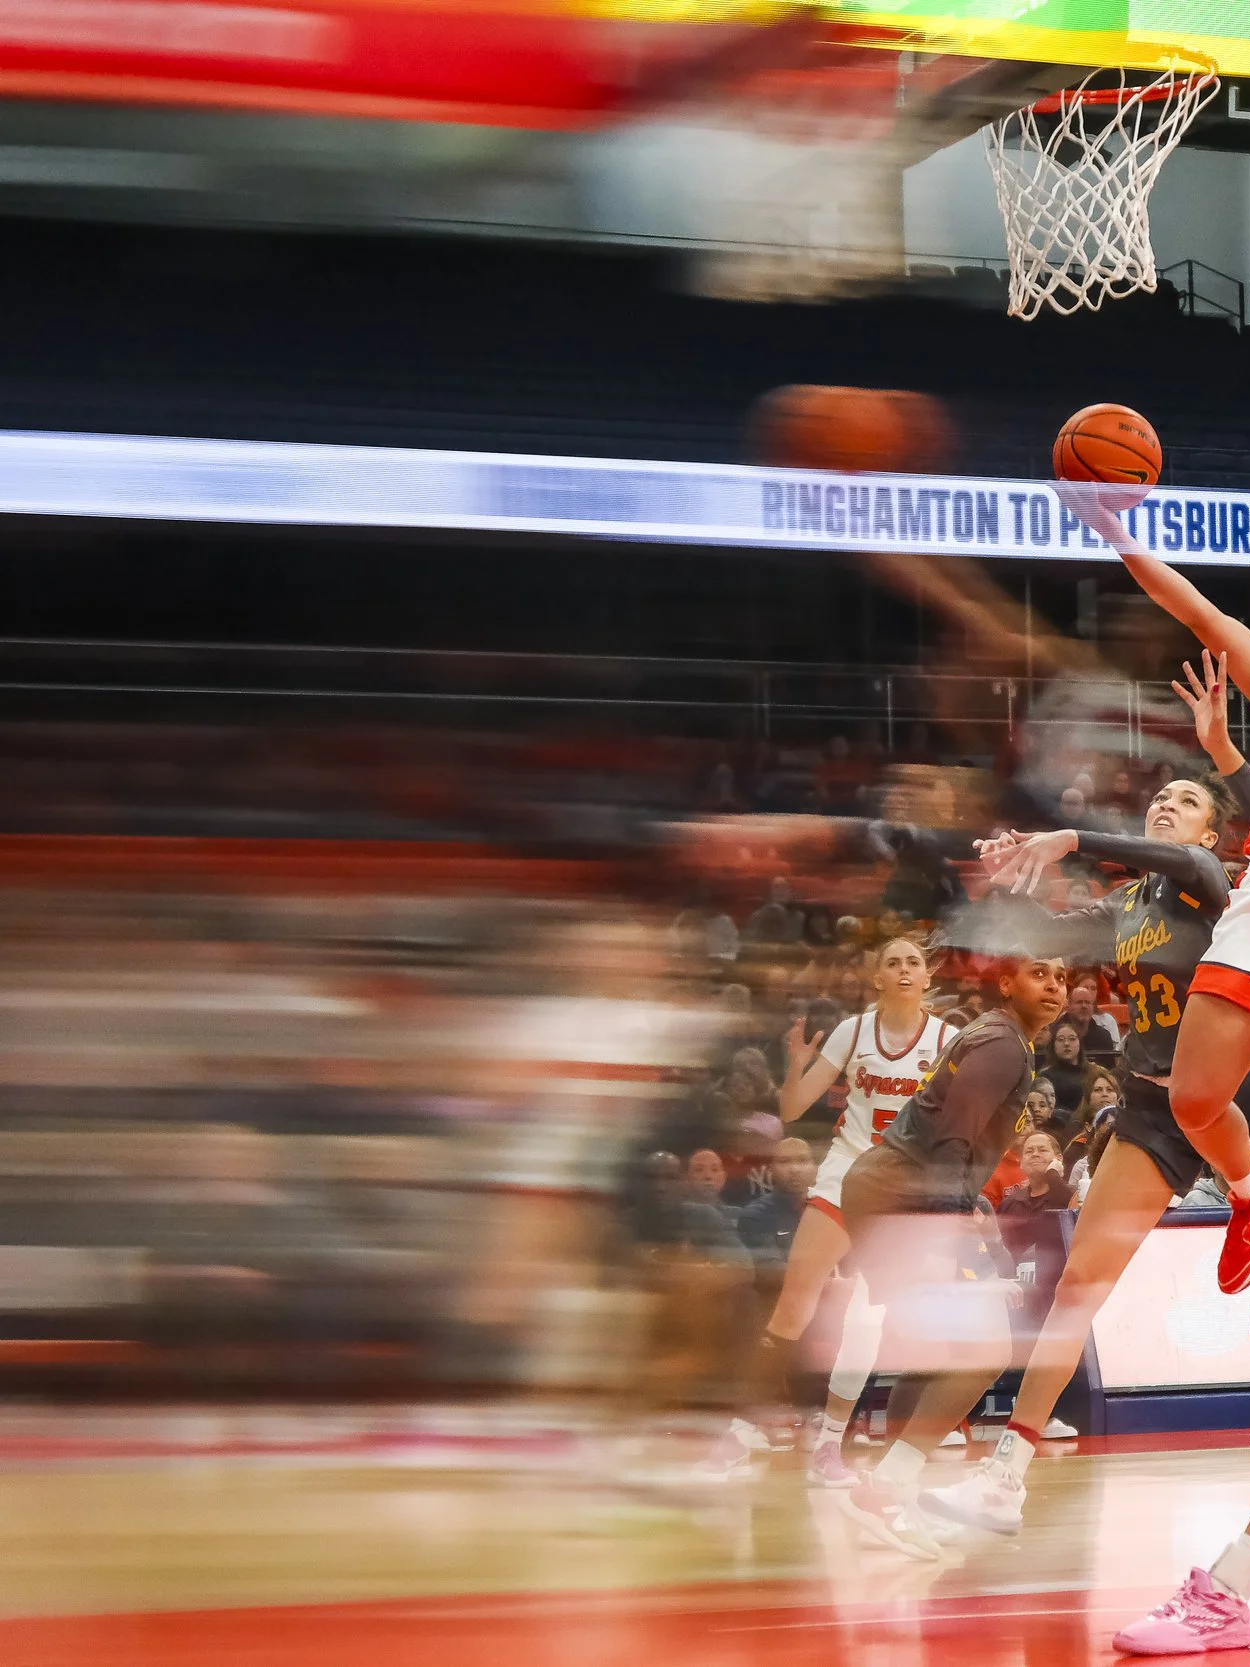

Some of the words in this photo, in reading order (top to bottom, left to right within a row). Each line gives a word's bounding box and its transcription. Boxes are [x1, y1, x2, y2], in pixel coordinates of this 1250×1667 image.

[762, 480, 999, 544] BINGHAMTON
[1008, 493, 1050, 546] TO
[1128, 973, 1181, 1034] 33
